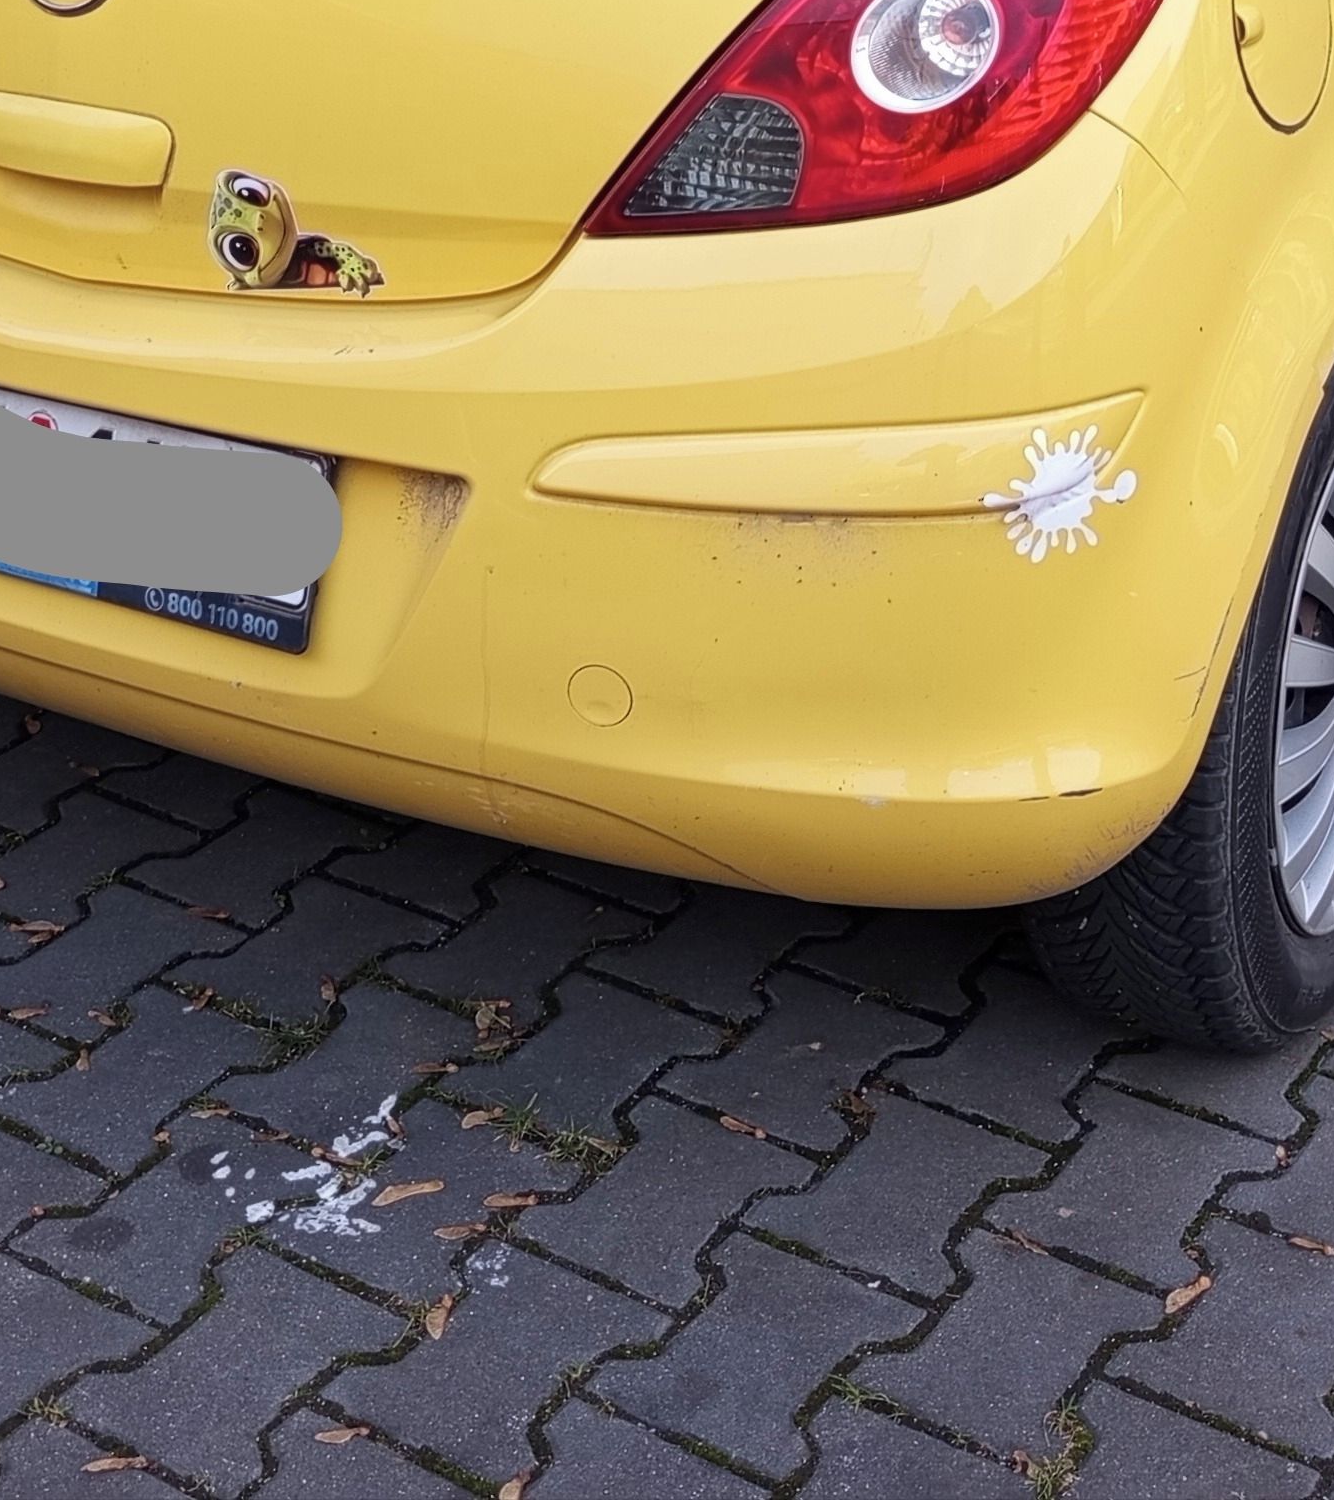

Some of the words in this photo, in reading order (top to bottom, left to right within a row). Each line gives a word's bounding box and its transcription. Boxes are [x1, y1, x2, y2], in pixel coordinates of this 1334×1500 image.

[166, 592, 203, 621] 800
[208, 603, 238, 630] 110
[241, 612, 279, 642] 800
